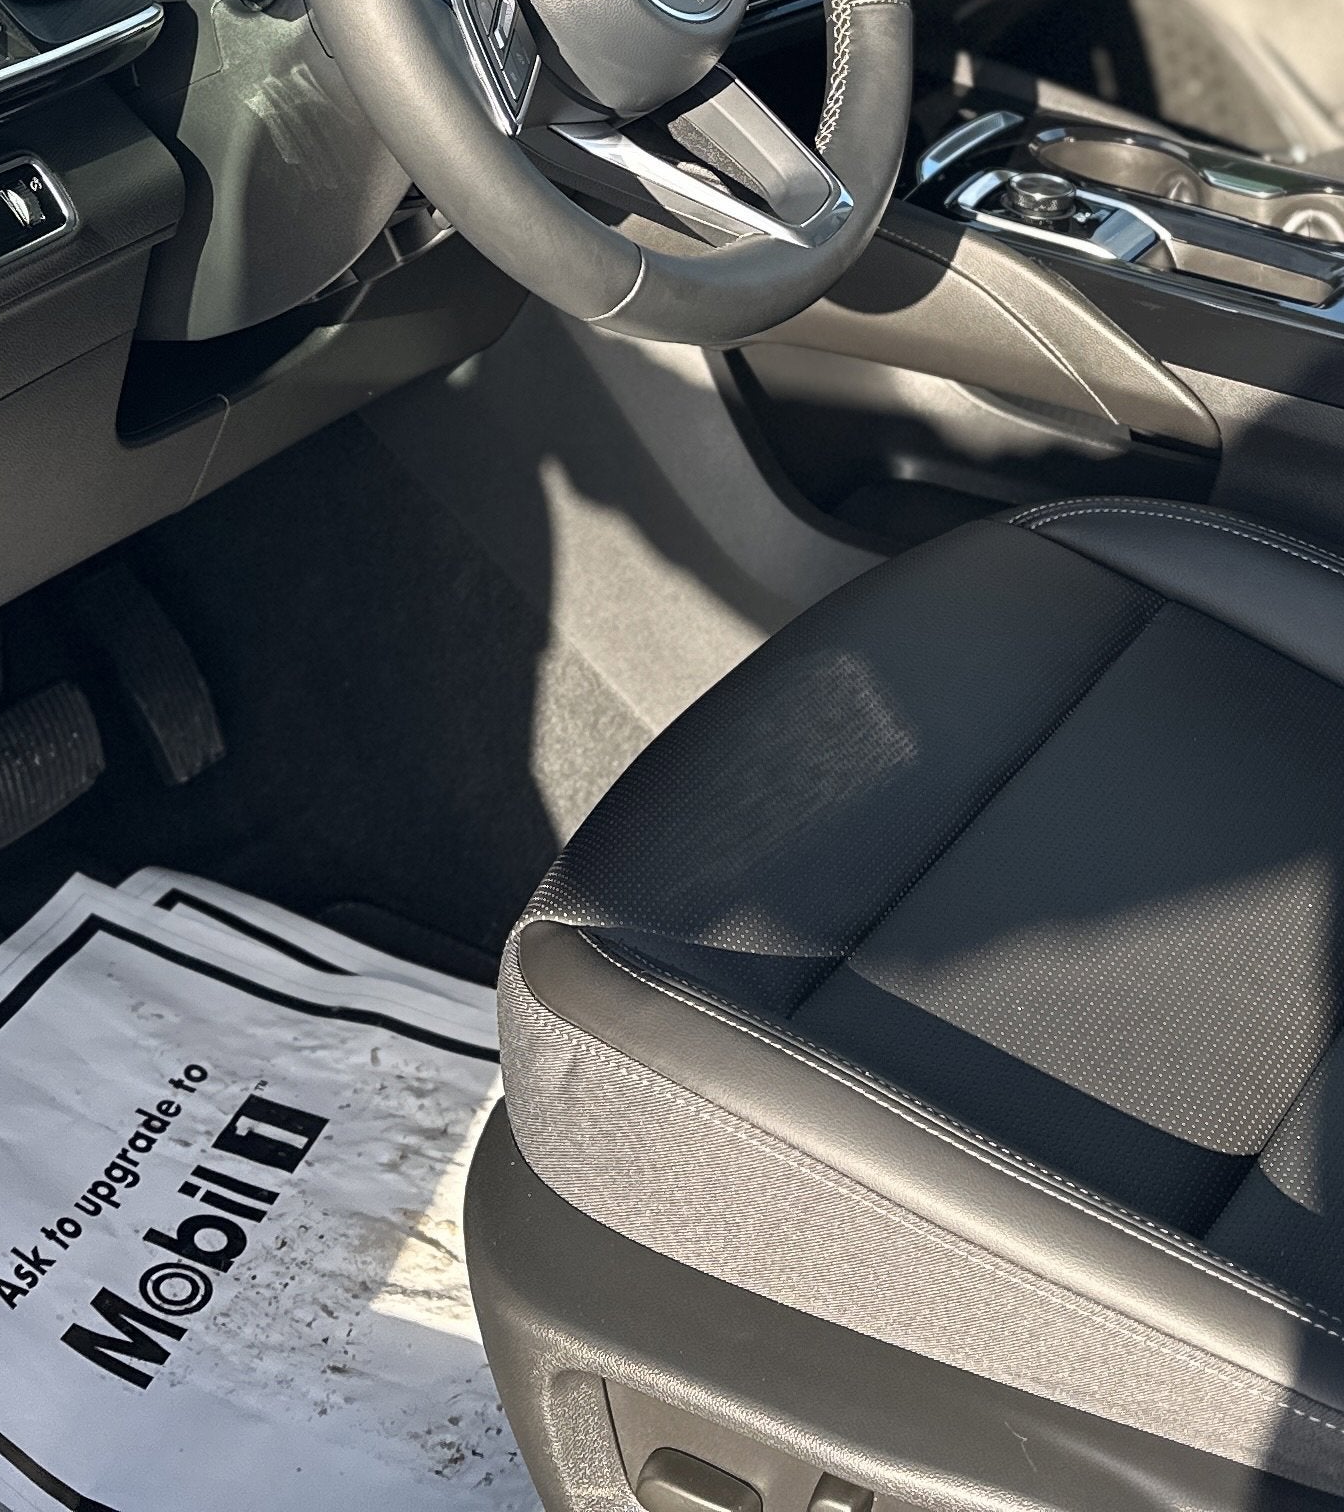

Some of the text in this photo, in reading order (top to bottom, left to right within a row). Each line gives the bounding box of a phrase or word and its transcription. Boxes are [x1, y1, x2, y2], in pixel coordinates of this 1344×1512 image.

[40, 1216, 82, 1251] to
[73, 1099, 182, 1217] upgrade
[168, 1063, 208, 1094] to
[60, 1164, 281, 1391] Mobil
